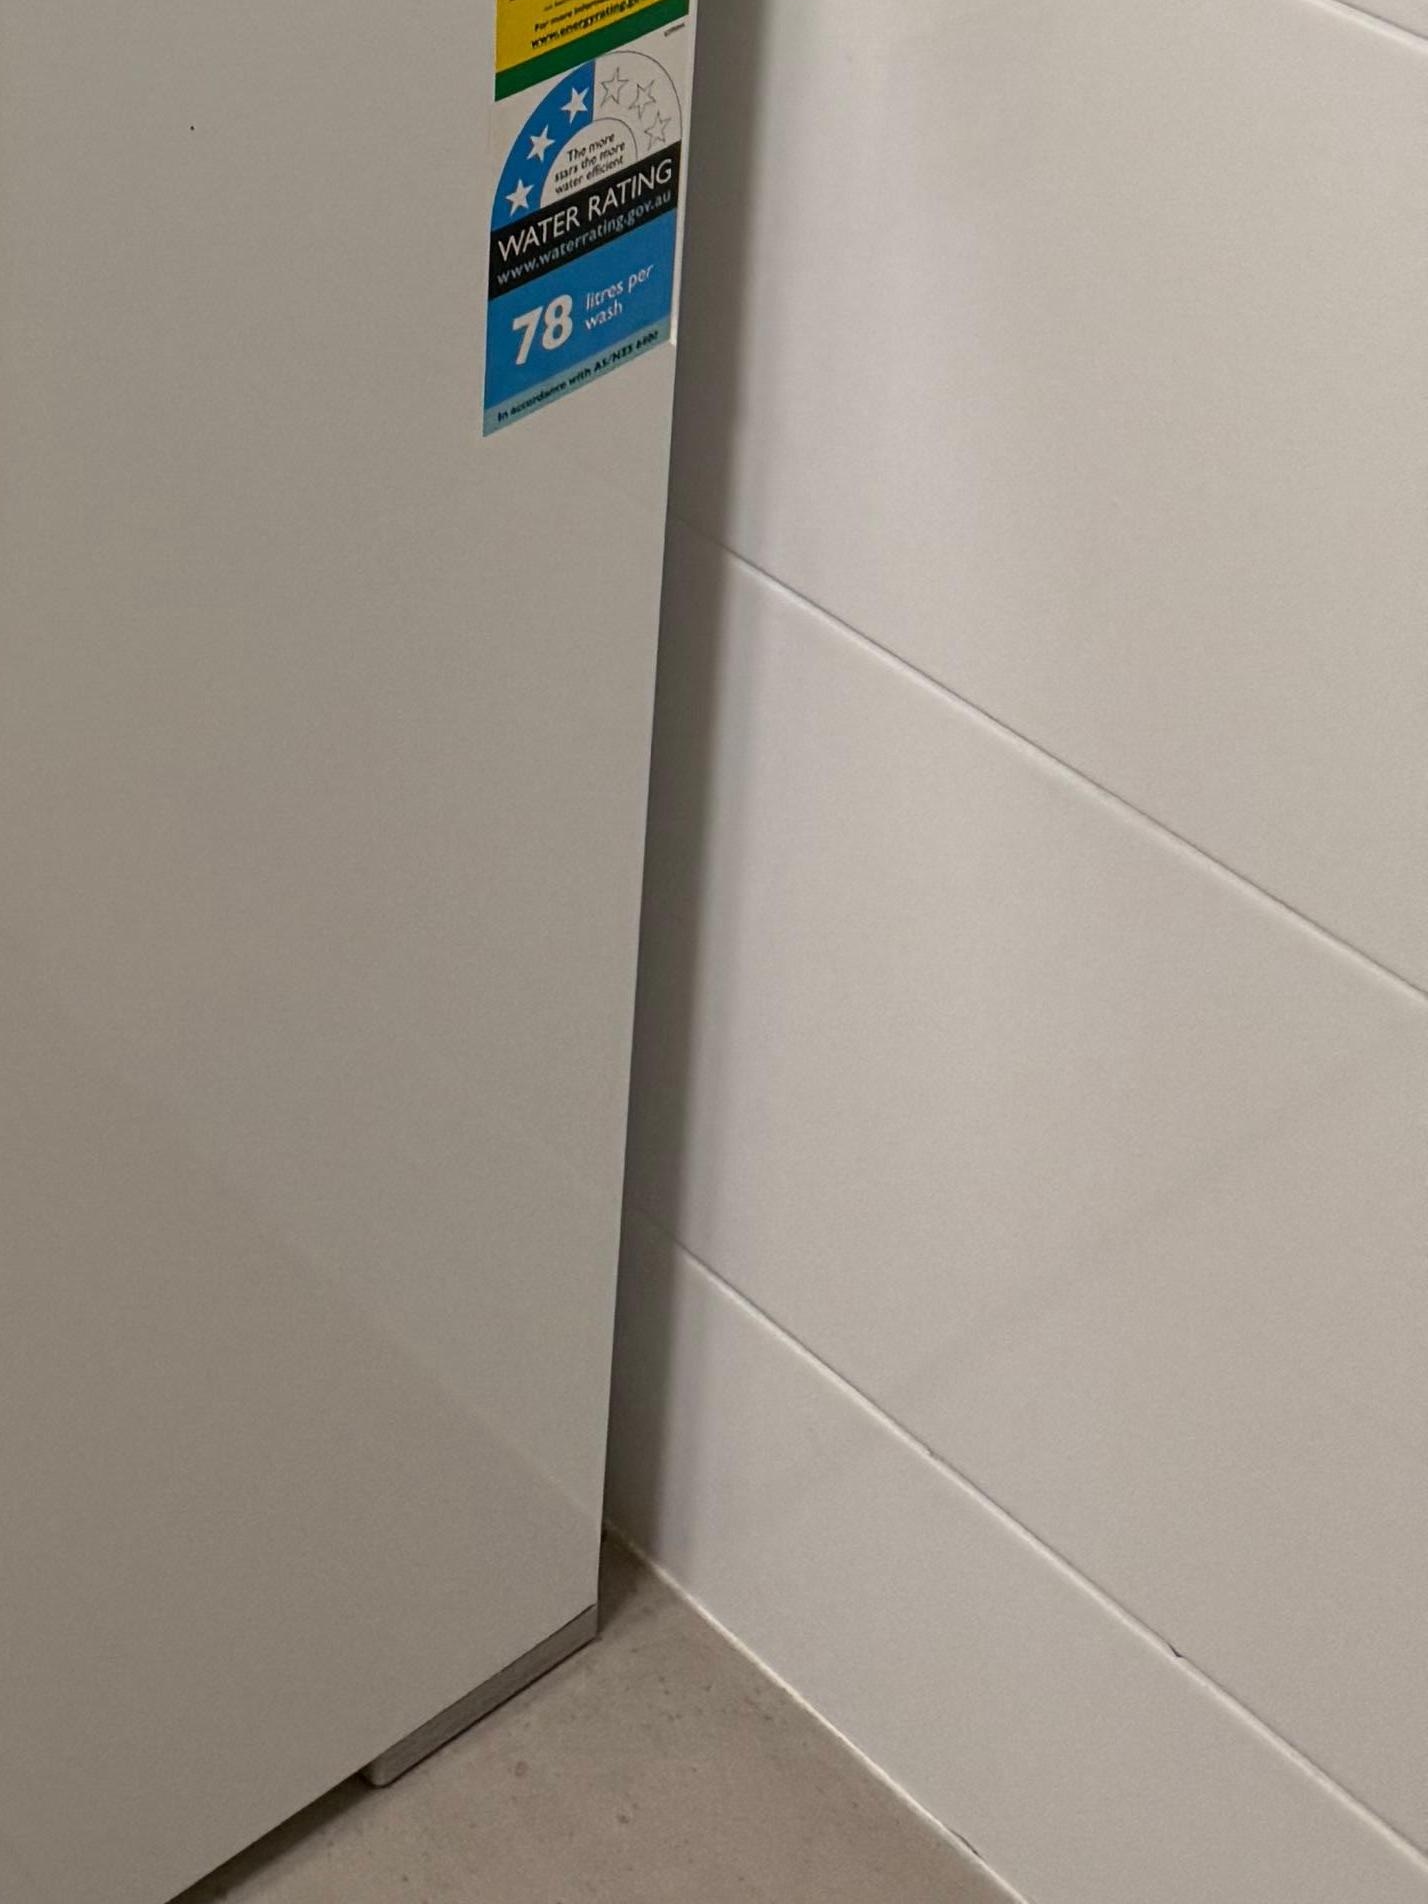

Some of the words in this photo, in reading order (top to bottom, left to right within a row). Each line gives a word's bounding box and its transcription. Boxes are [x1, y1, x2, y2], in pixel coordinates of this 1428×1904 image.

[534, 21, 549, 32] For
[551, 11, 573, 24] more
[555, 166, 579, 182] stars
[581, 155, 597, 170] the
[599, 143, 625, 160] more
[567, 147, 586, 162] The
[588, 134, 615, 150] more
[555, 174, 582, 194] water
[586, 155, 624, 181] efficient
[498, 205, 581, 263] WATER
[588, 158, 673, 222] RATING
[496, 189, 672, 286] www.waterrating.gov.au
[586, 281, 624, 310] litres
[628, 264, 654, 293] per
[512, 294, 573, 366] 78
[584, 300, 623, 331] wash
[497, 411, 509, 423] In
[510, 380, 567, 417] accordance
[569, 368, 592, 386] with
[594, 343, 633, 372] AS/NZS
